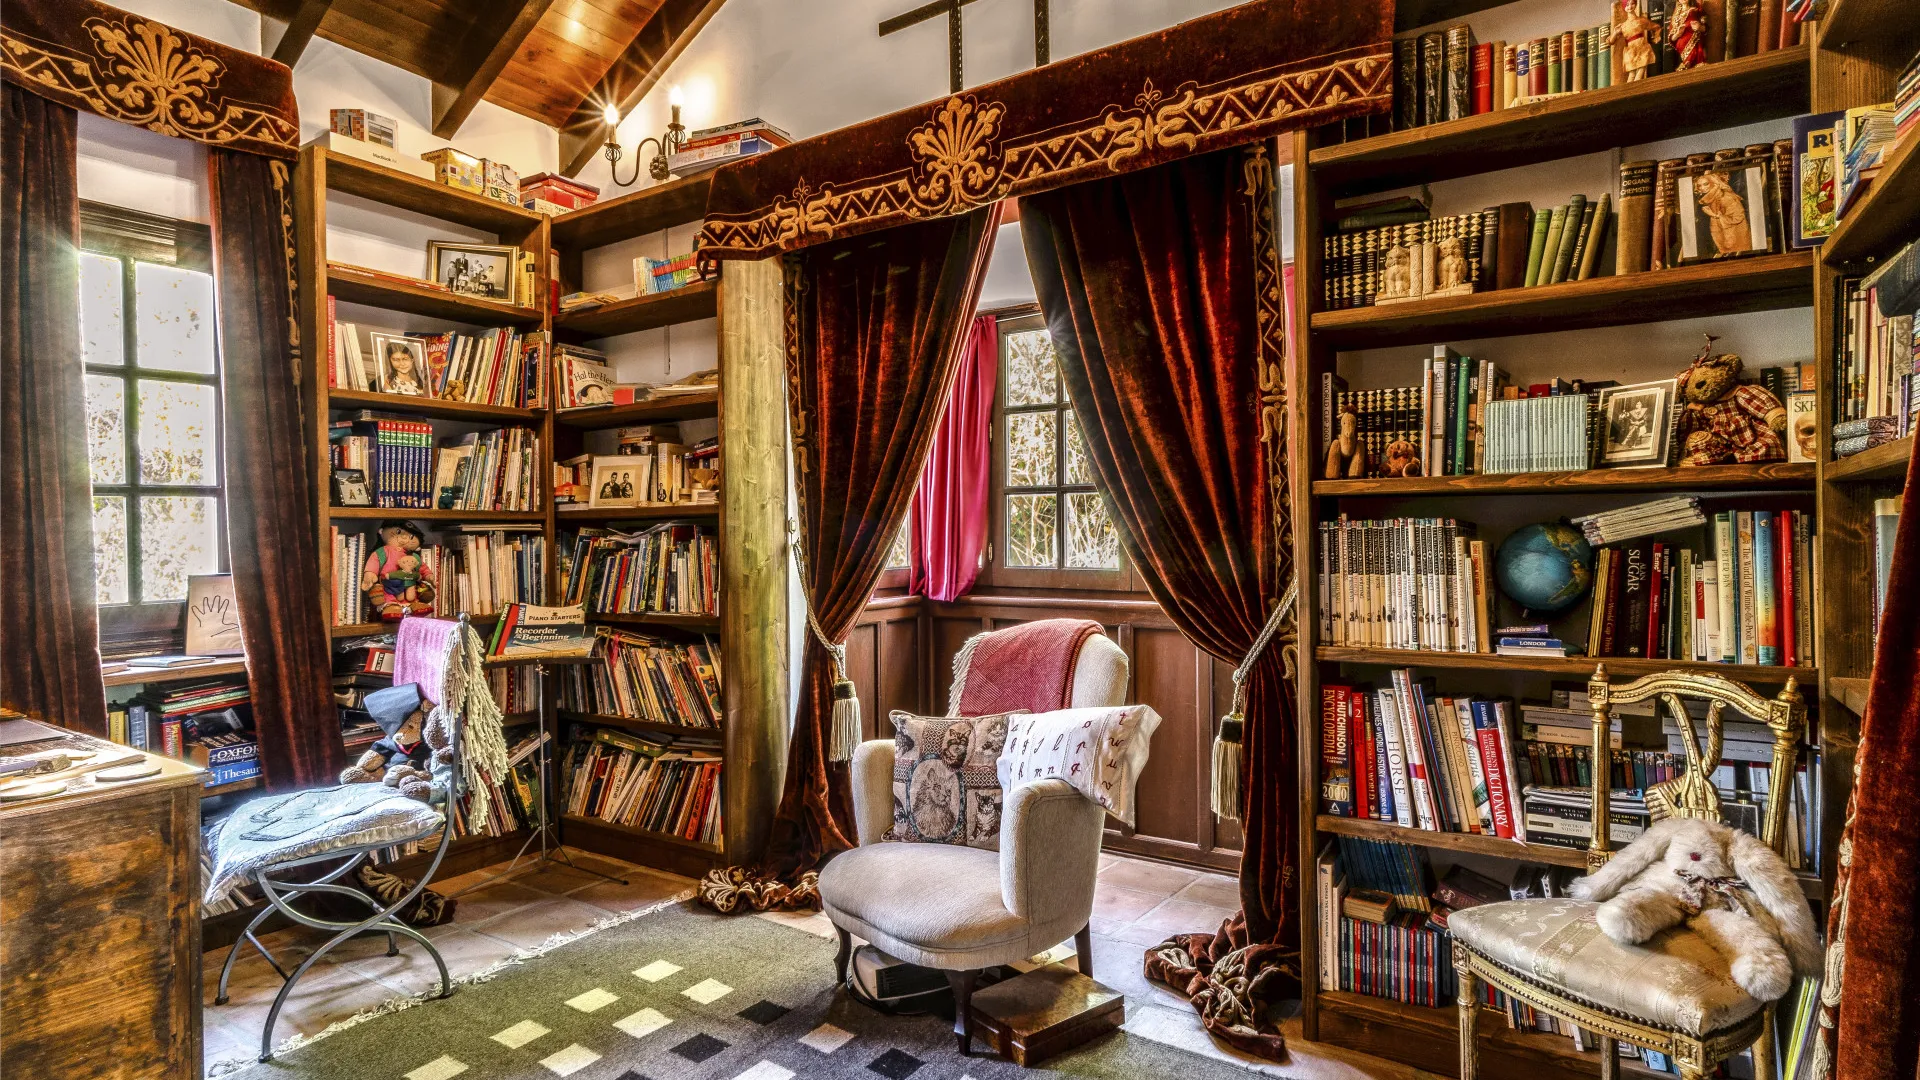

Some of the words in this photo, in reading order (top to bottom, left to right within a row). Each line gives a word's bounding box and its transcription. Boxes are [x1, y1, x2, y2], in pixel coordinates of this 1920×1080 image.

[1622, 178, 1651, 187] ORGANIC
[1580, 223, 1588, 236] PRIDE
[574, 371, 587, 381] Hal
[588, 370, 599, 379] the
[1627, 549, 1640, 592] SUGAR
[1743, 561, 1752, 580] World
[1744, 590, 1754, 640] Winnie-the-Pooh
[1604, 623, 1613, 635] Cup
[1355, 709, 1361, 718] 2
[1373, 697, 1382, 726] TIMELINES
[1480, 704, 1488, 726] CHAMBERS
[1082, 720, 1092, 728] o
[1119, 712, 1127, 725] t
[1323, 689, 1335, 753] ENCYCLOPEDIA
[1336, 701, 1347, 755] HUTCHINSON
[1076, 741, 1086, 754] p
[1108, 737, 1124, 747] w
[1376, 732, 1384, 753] WORLD
[217, 745, 259, 759] OXFOR
[1452, 732, 1464, 767] PINOCCHIO
[1047, 766, 1054, 775] n
[1106, 759, 1117, 769] u
[1388, 740, 1405, 795] HORSE
[222, 767, 261, 779] Thesaur
[1482, 734, 1492, 767] ILLUSTRATED
[1488, 768, 1508, 828] DICTIONARY
[1322, 786, 1347, 798] 2000
